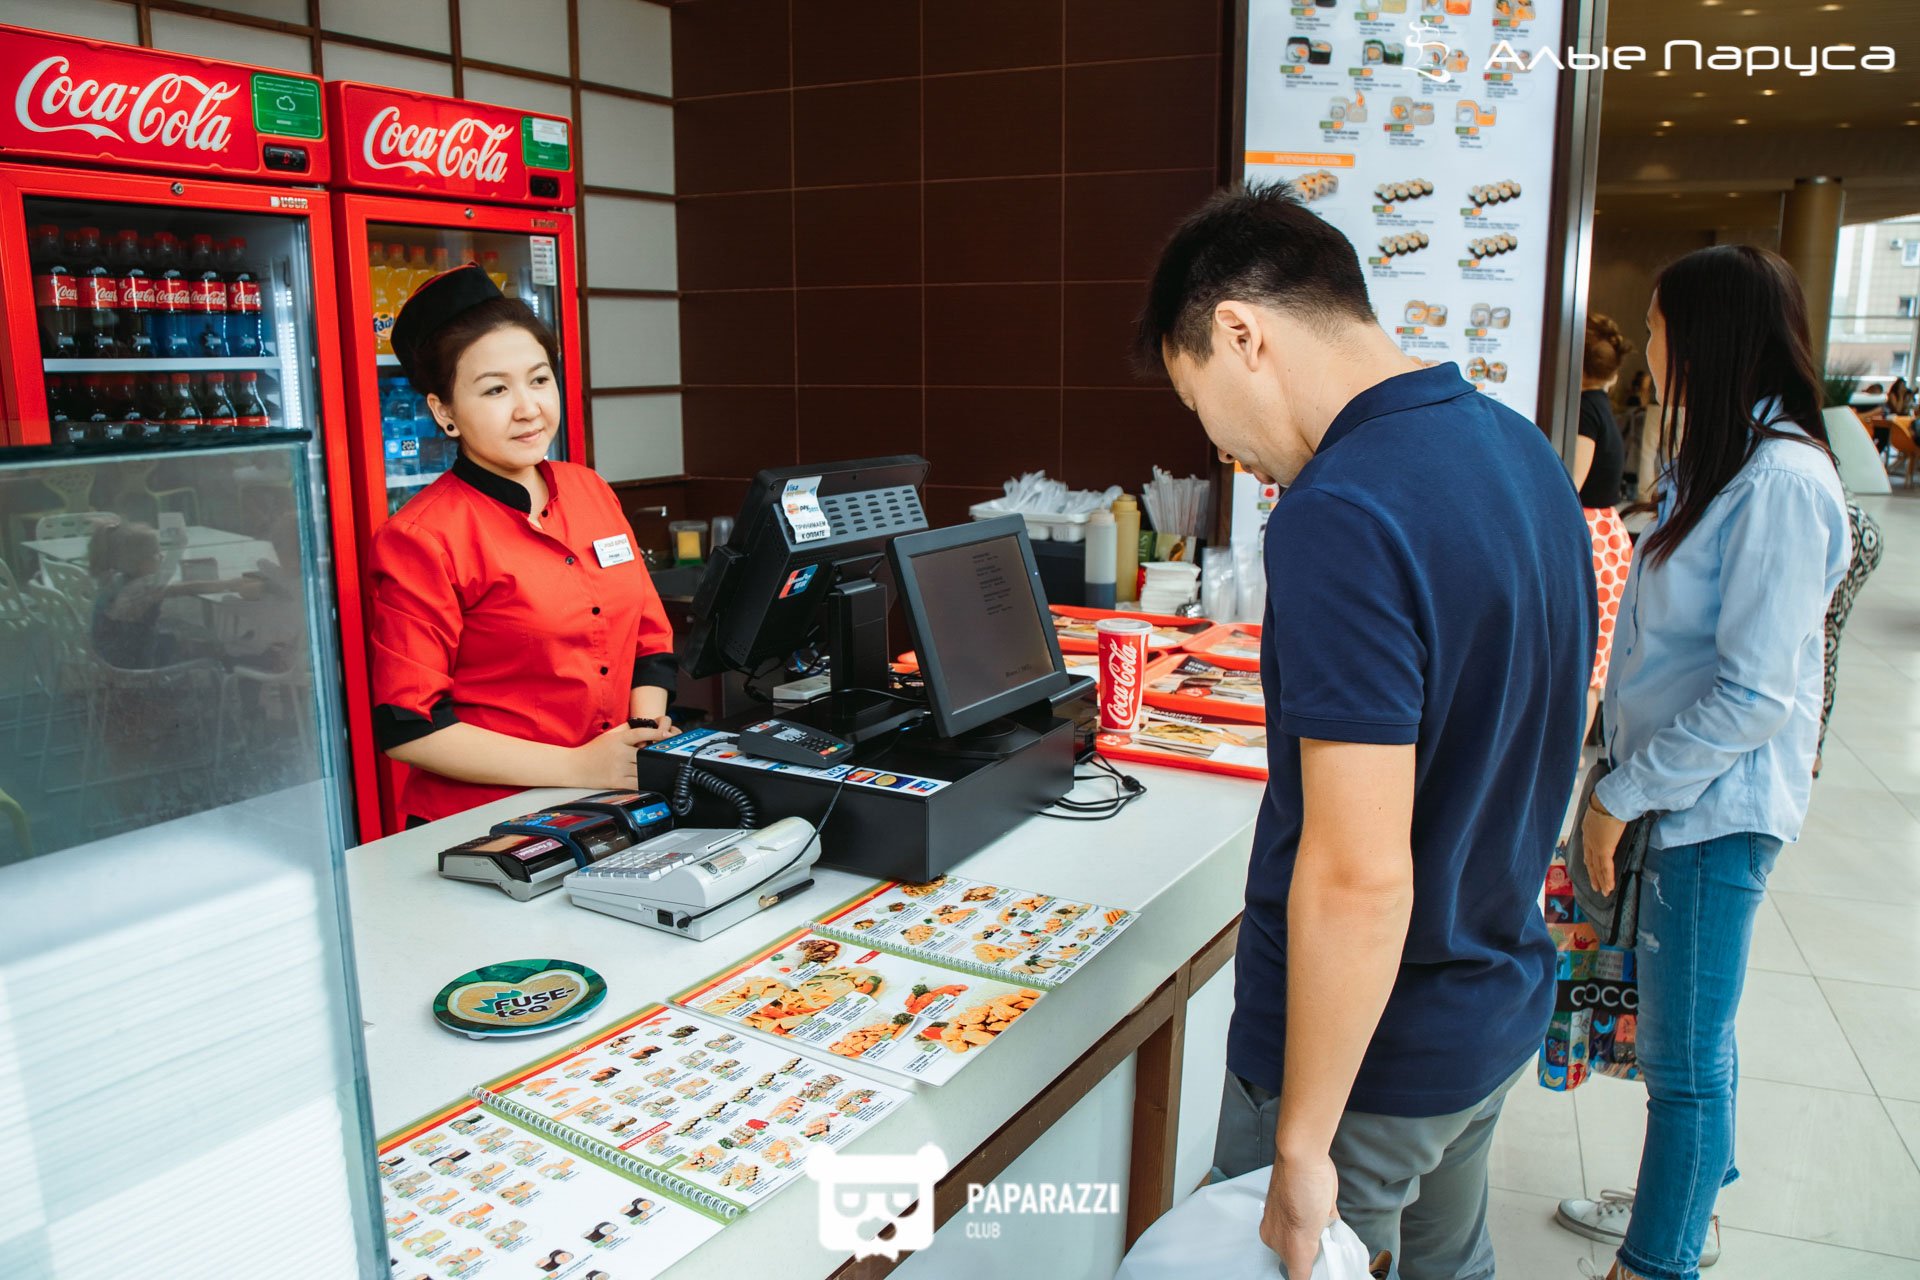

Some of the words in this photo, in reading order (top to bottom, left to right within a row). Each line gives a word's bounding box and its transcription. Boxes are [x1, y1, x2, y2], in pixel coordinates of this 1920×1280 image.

[15, 55, 241, 152] Coca-Cola
[363, 105, 515, 182] Coca-Cola
[1107, 638, 1138, 727] Coca-Cola
[495, 1005, 549, 1018] tea
